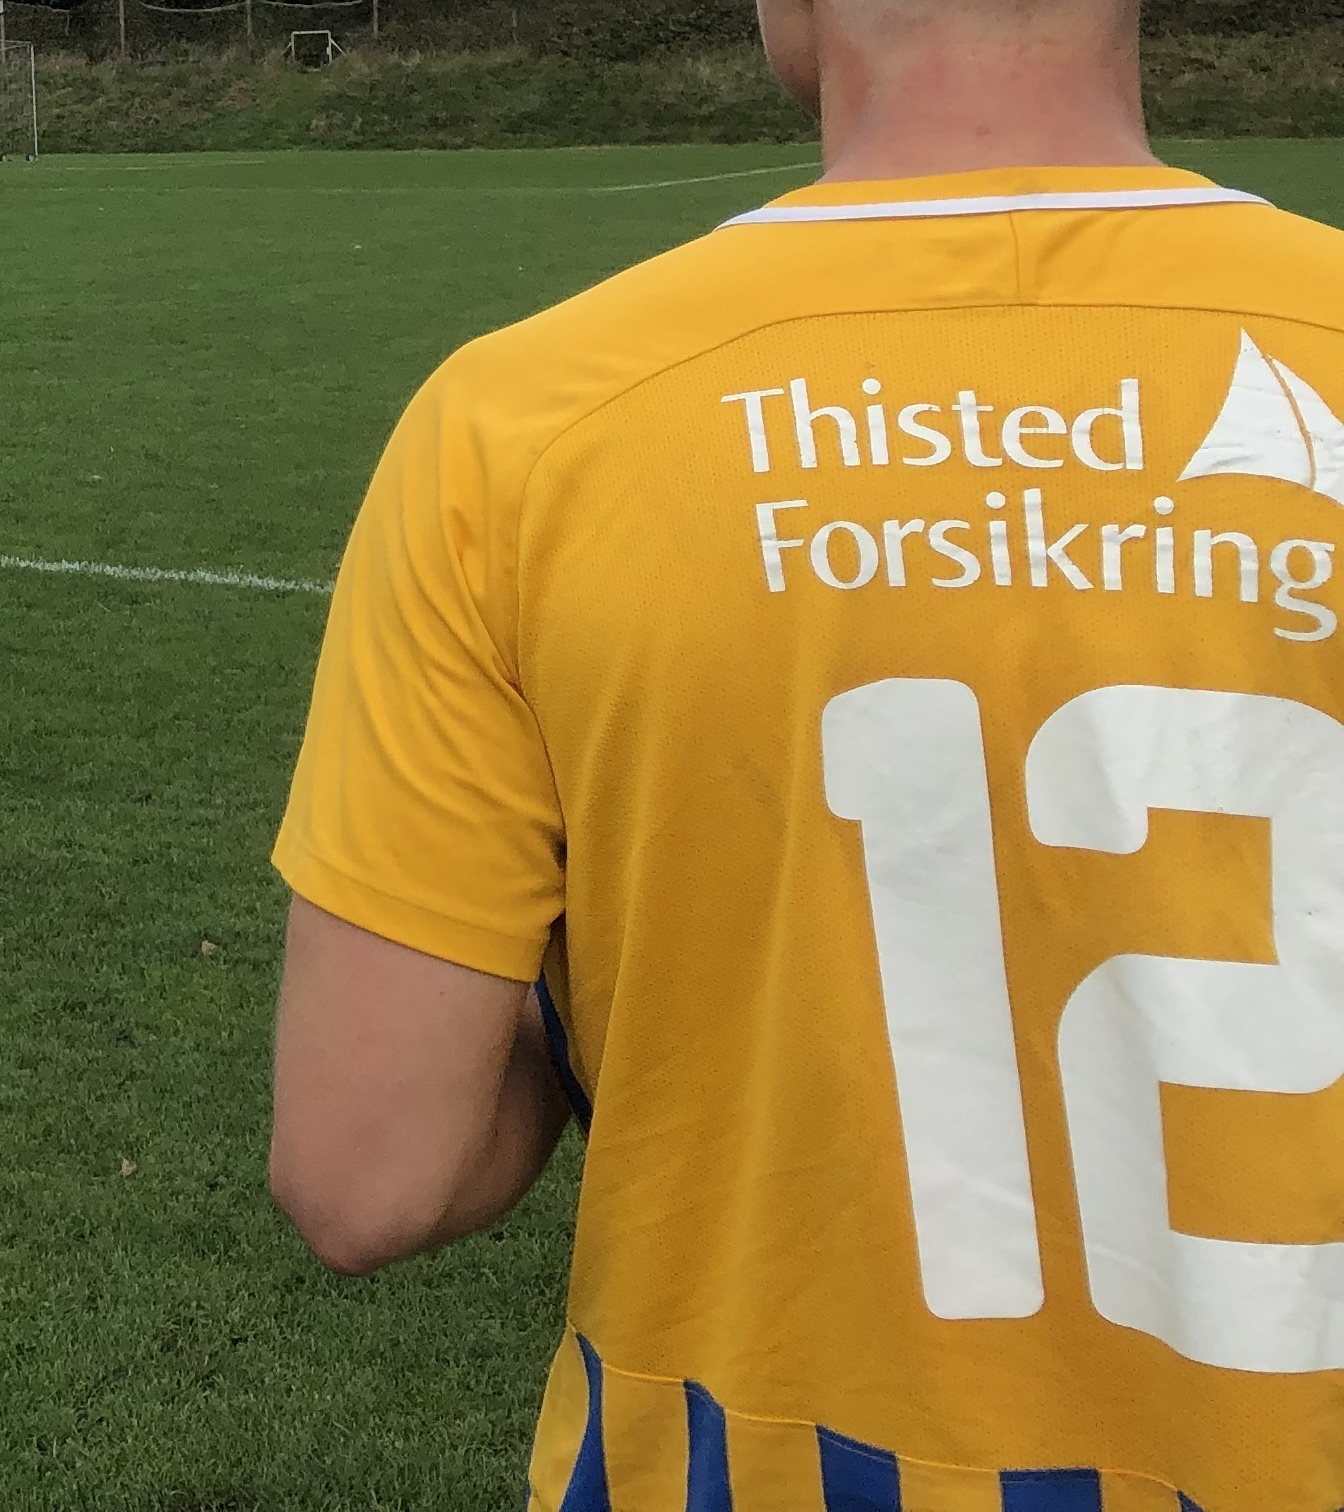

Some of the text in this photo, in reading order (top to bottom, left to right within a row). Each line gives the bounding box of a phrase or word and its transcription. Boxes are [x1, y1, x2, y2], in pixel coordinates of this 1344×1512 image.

[720, 376, 1145, 473] Thisted
[752, 487, 1339, 643] Forsikring
[821, 676, 1344, 1374] 12
